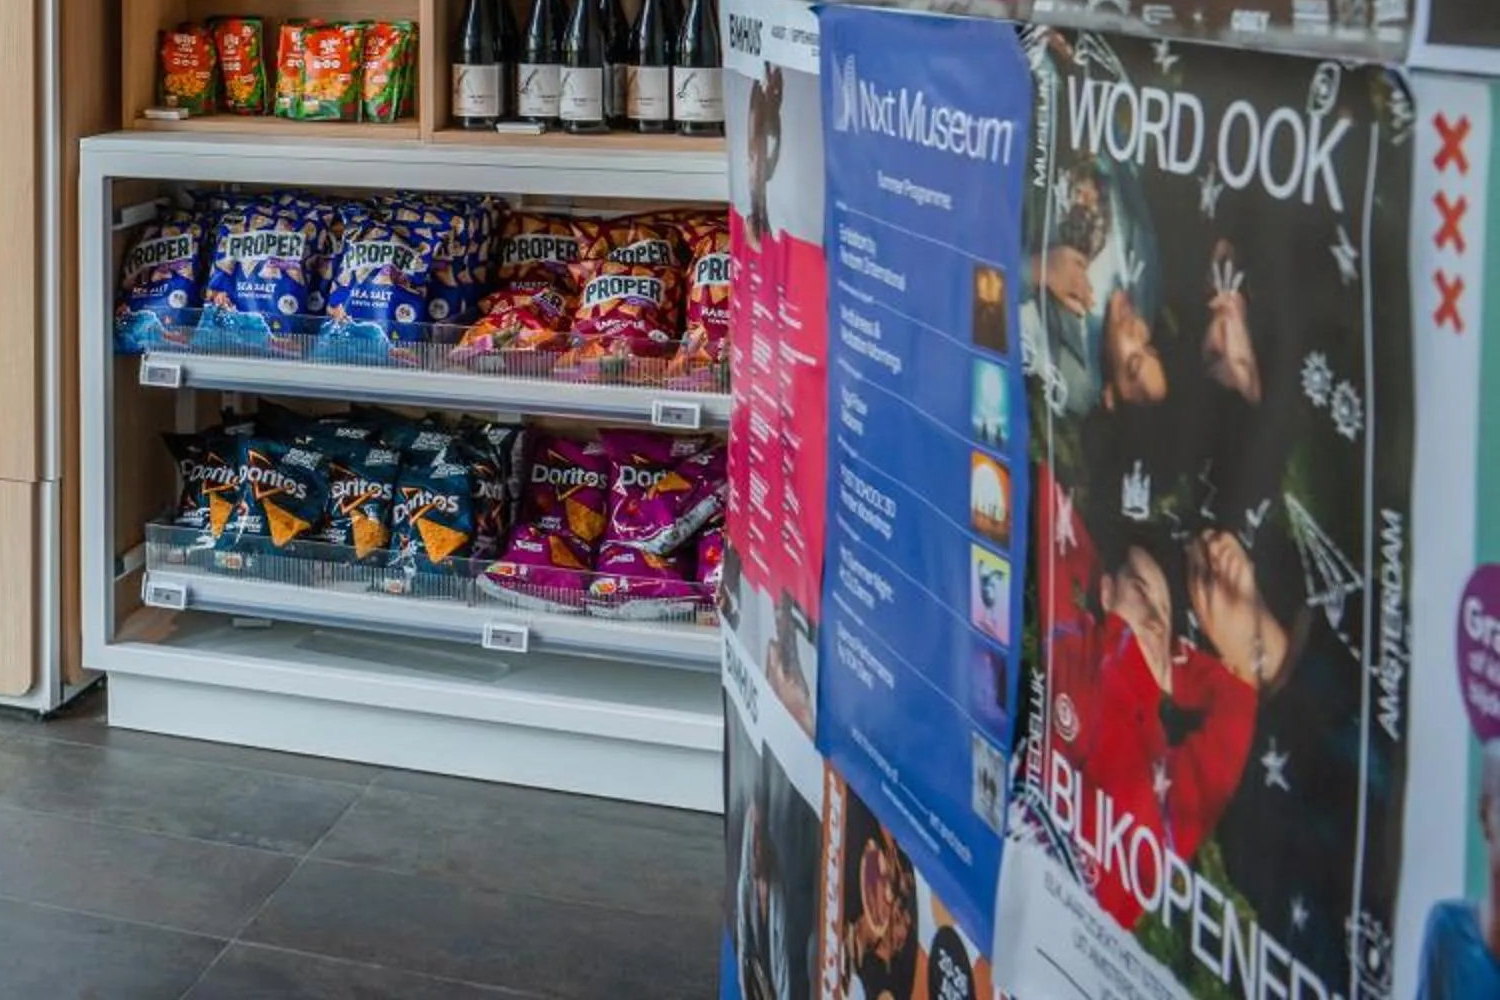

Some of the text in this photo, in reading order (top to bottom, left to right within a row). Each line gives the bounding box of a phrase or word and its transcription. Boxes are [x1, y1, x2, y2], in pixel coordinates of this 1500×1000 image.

[859, 79, 1014, 167] Nxt Museum
[1032, 66, 1050, 188] MUSEUM
[1067, 74, 1351, 212] WORD OOK
[229, 234, 303, 258] PROPER
[344, 242, 416, 272] PROPER
[503, 236, 581, 265] PROPER
[236, 281, 277, 292] SEA SALT
[350, 289, 394, 301] SEA SALT
[585, 278, 664, 306] PROPER
[331, 478, 393, 500] oritos
[531, 464, 608, 490] Doritos
[1376, 507, 1404, 742] AMSTERDAM
[1024, 666, 1047, 796] TEDELIJK
[1050, 749, 1350, 1000] BLIKOPENER
